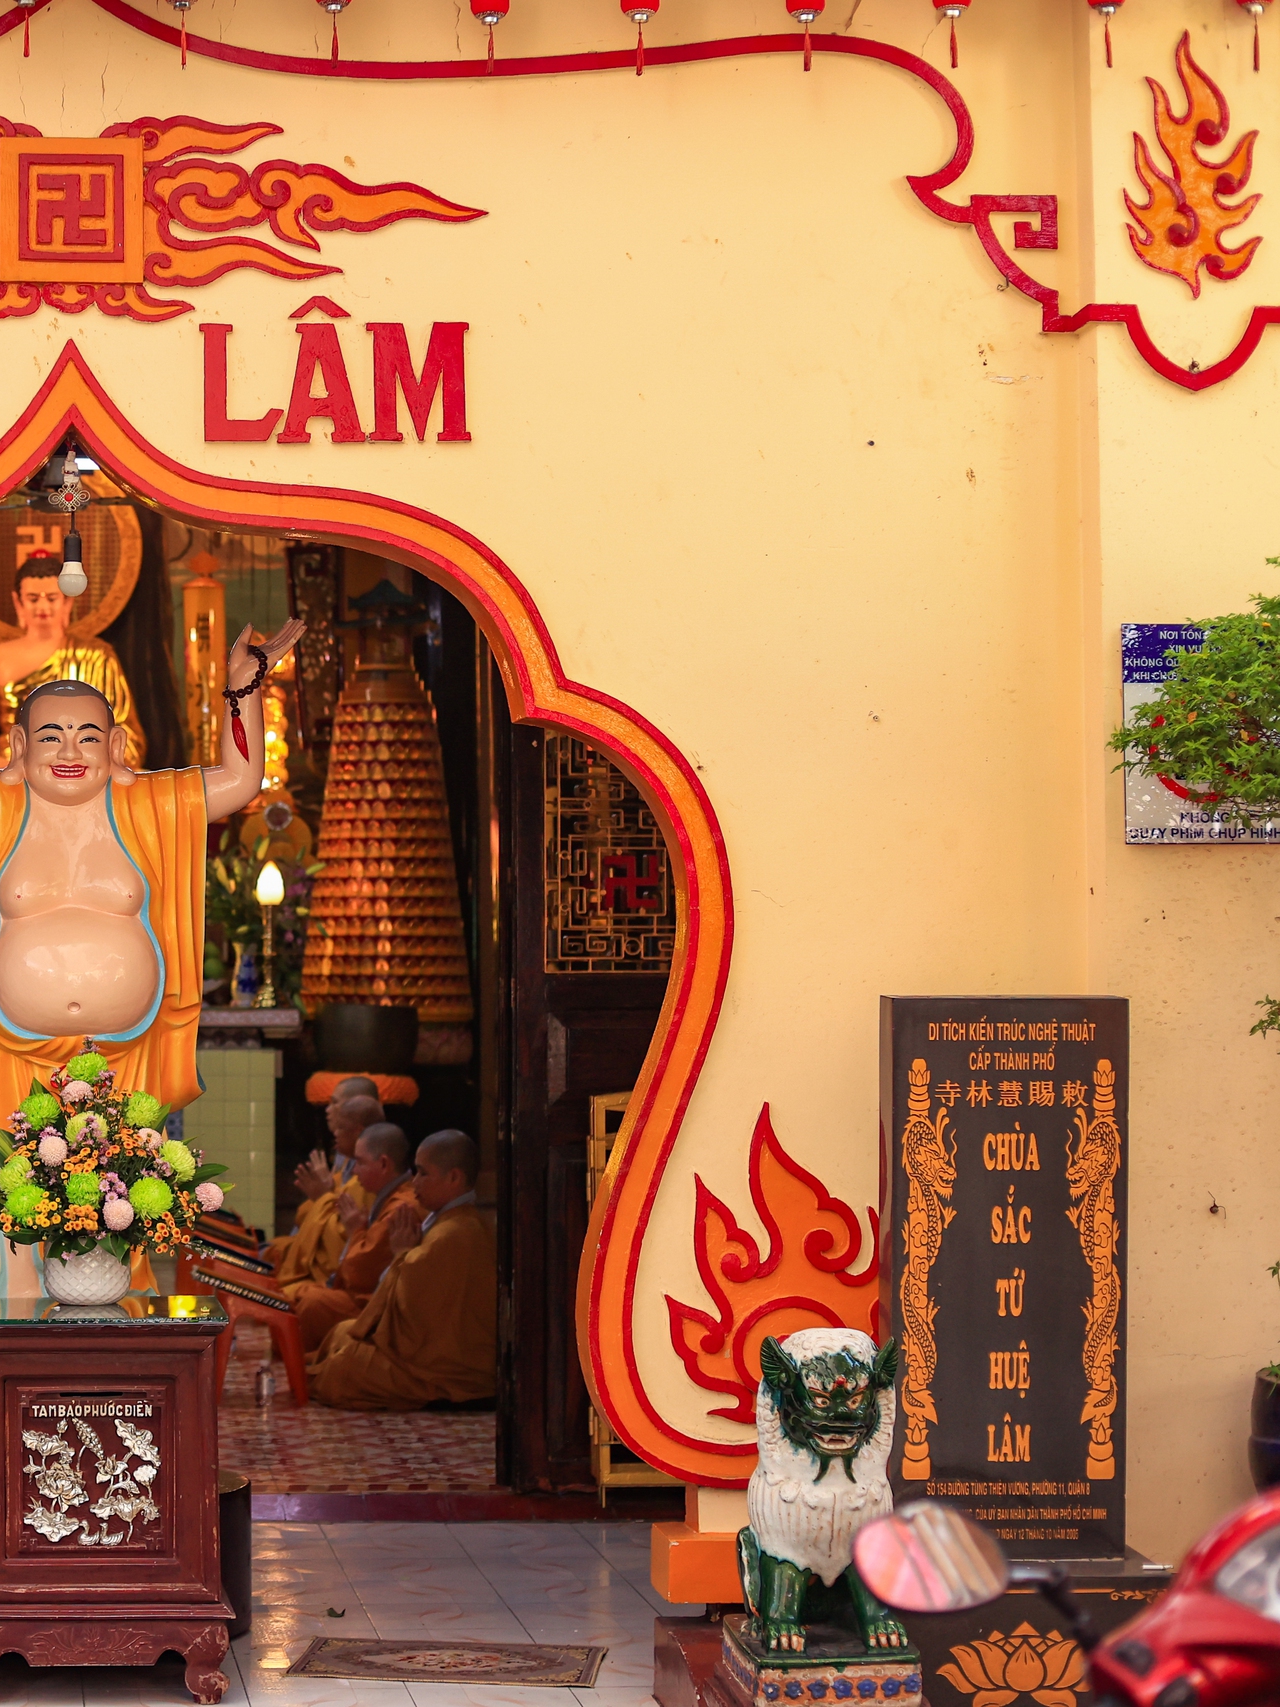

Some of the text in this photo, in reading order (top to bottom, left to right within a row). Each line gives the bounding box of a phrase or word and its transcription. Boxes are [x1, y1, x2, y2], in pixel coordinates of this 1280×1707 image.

[198, 295, 472, 444] LÂM
[1159, 630, 1178, 639] NƠI
[1126, 656, 1163, 667] KHÔNG
[1171, 828, 1204, 839] PHIM
[1208, 828, 1246, 841] CHỤP
[928, 1015, 1096, 1045] DI TÍCH KIẾN TRÚC NGHỆ THUẬT
[970, 1044, 1056, 1071] CẤP THÀNH PHỐ
[983, 1122, 1040, 1171] CHÙA
[990, 1184, 1032, 1244] SẮC
[995, 1268, 1025, 1317] TỨ
[989, 1340, 1031, 1398] HUỆ
[987, 1412, 1032, 1463] LÂM
[926, 1478, 936, 1495] SỐ
[937, 1482, 947, 1495] 154
[948, 1480, 970, 1495] ĐƯỜNG
[971, 1480, 987, 1495] TÙNG
[1032, 1479, 1057, 1495] PHƯỜNG
[1068, 1479, 1085, 1497] QUẬN
[1086, 1482, 1090, 1495] 8
